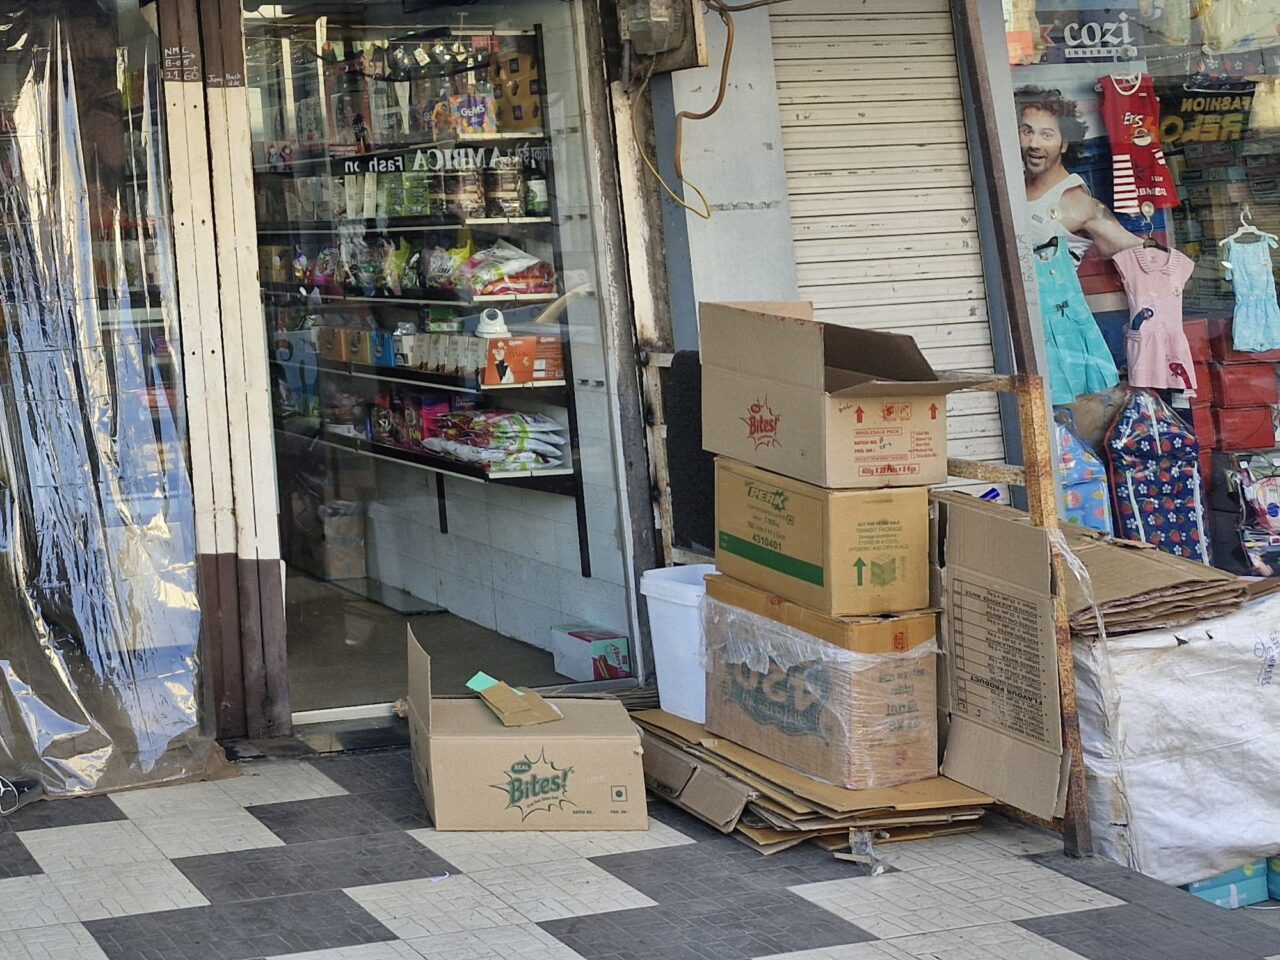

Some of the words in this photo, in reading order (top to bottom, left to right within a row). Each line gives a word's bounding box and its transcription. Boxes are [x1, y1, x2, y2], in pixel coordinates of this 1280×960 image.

[460, 104, 485, 117] GEMS
[748, 486, 787, 510] PERK
[970, 675, 1004, 692] PRODUCT
[1006, 687, 1042, 705] FLAVOUR
[509, 769, 568, 805] Bites!
